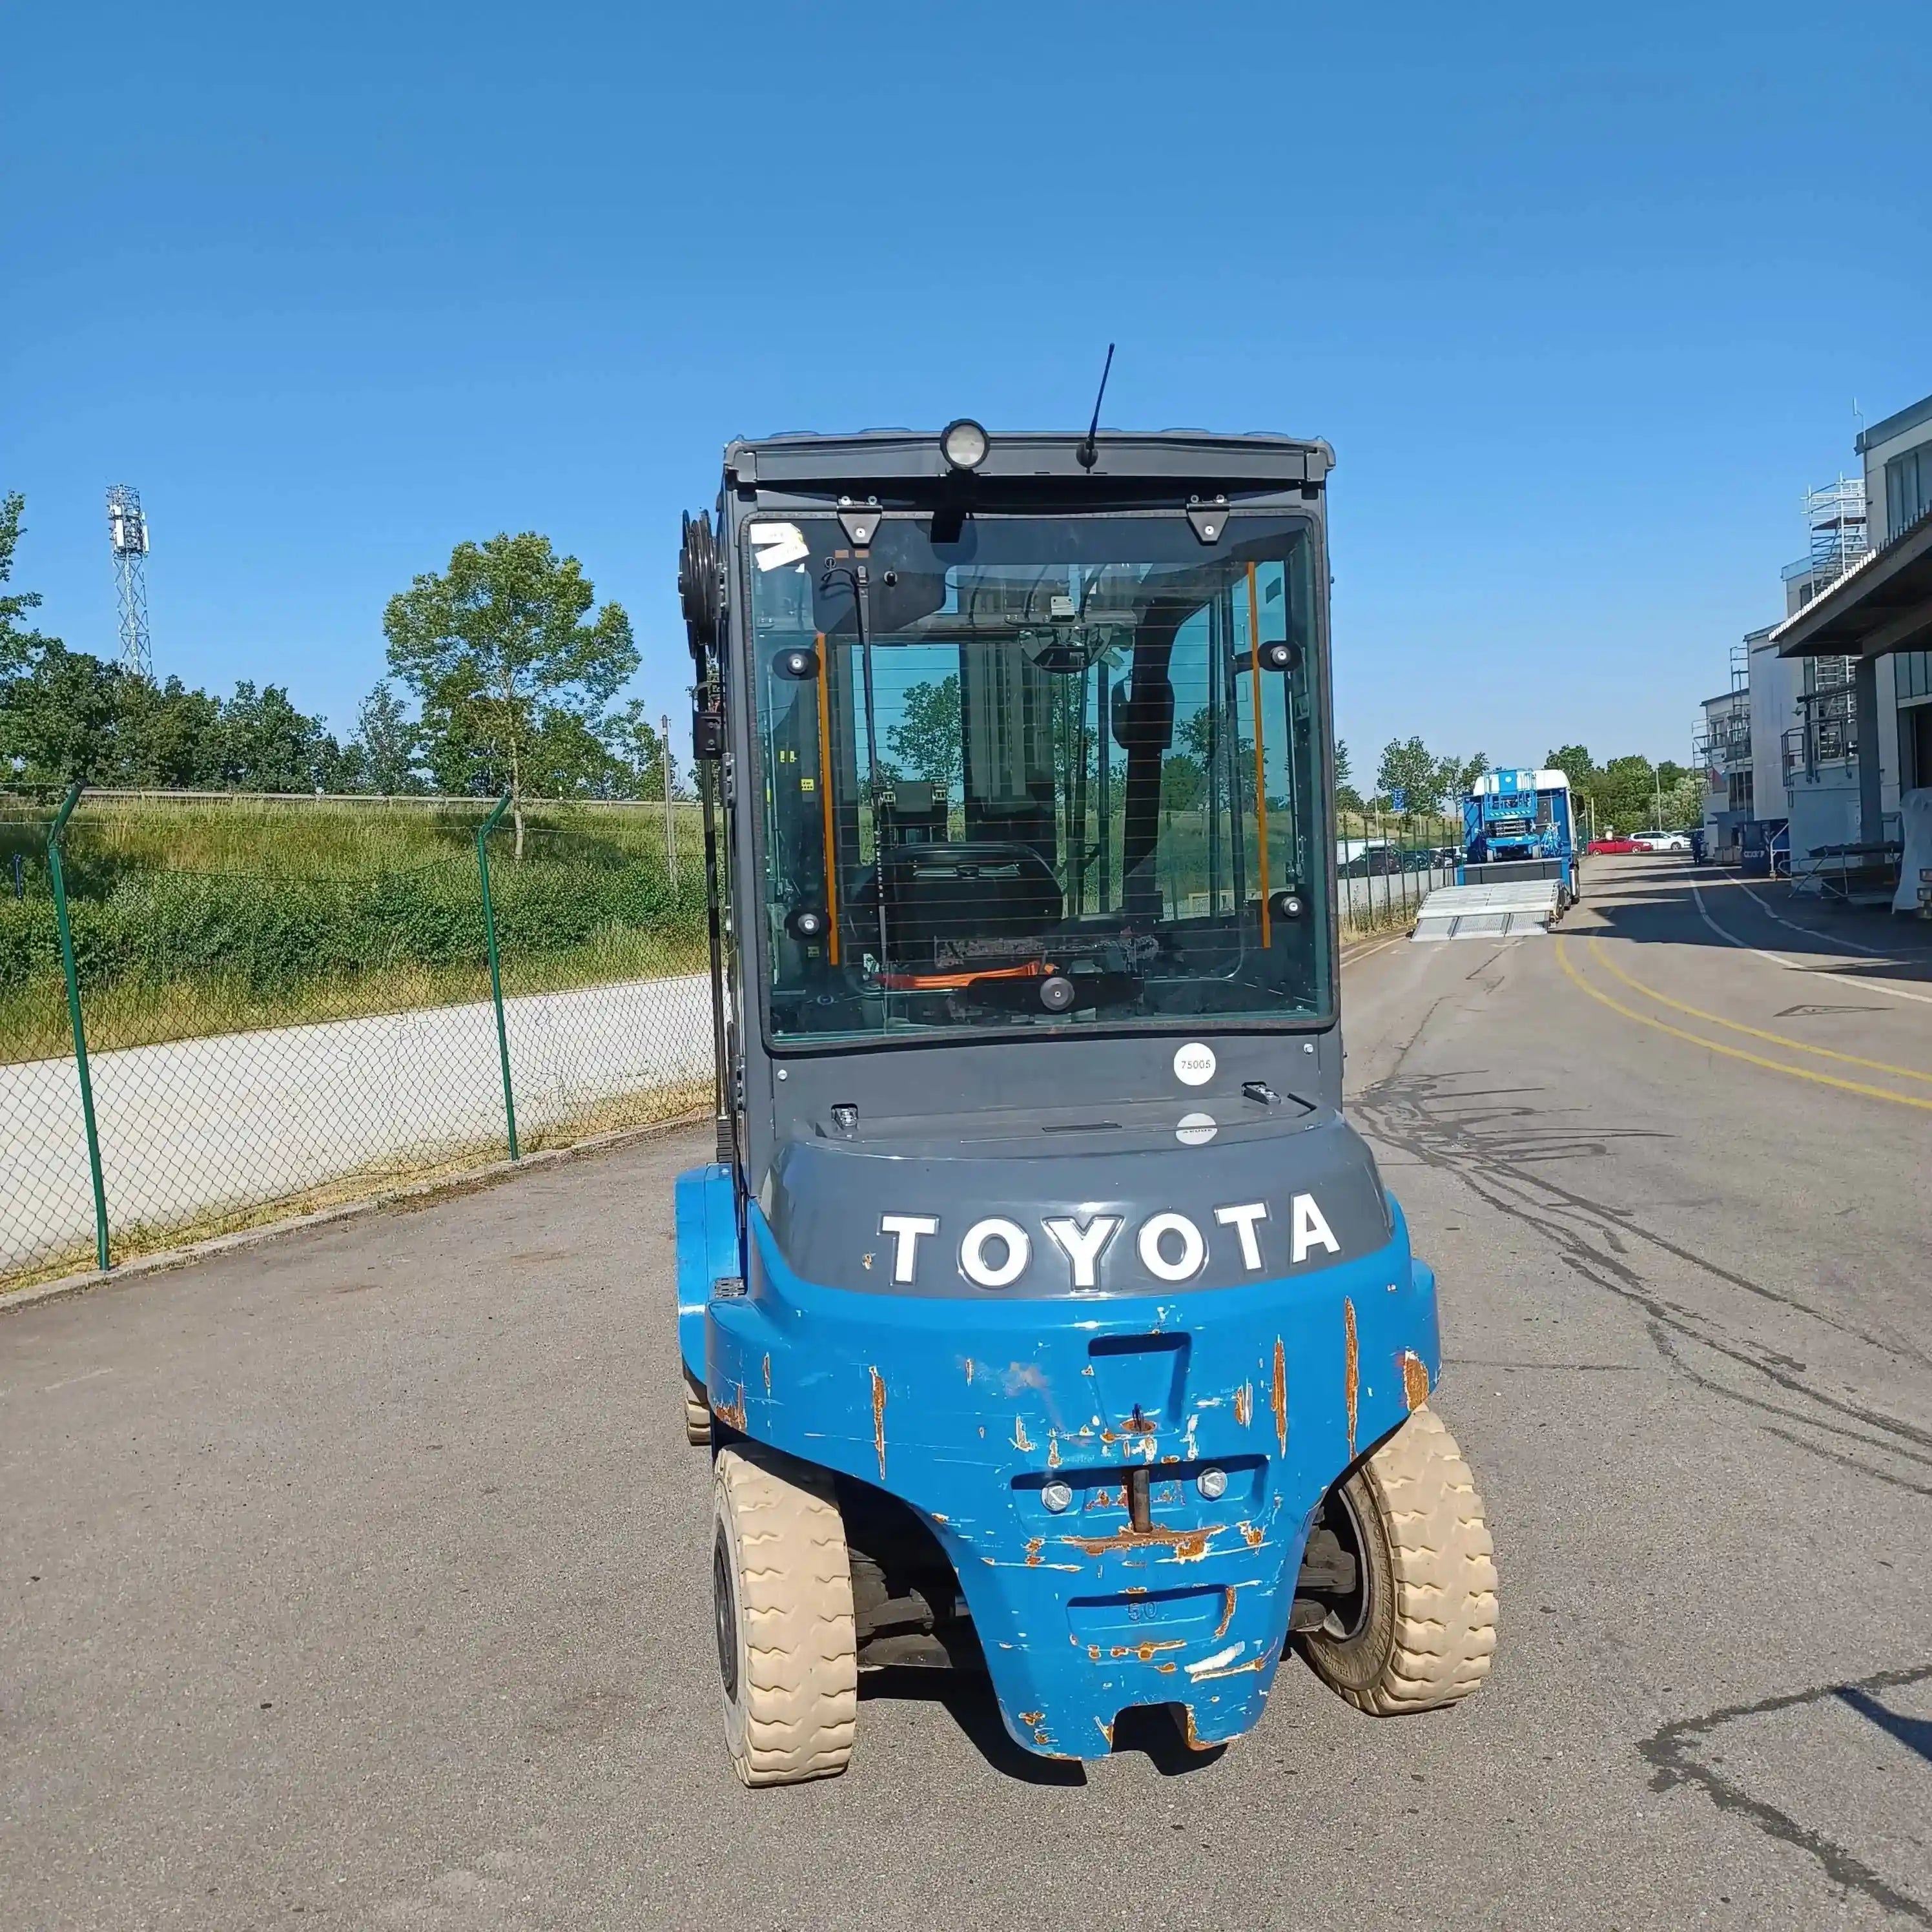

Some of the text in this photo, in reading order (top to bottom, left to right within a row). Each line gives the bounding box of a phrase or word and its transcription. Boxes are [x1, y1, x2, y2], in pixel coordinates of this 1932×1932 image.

[1181, 1059, 1211, 1069] 75005
[881, 1191, 1343, 1289] TOYOTA
[1127, 1603, 1158, 1622] 50
